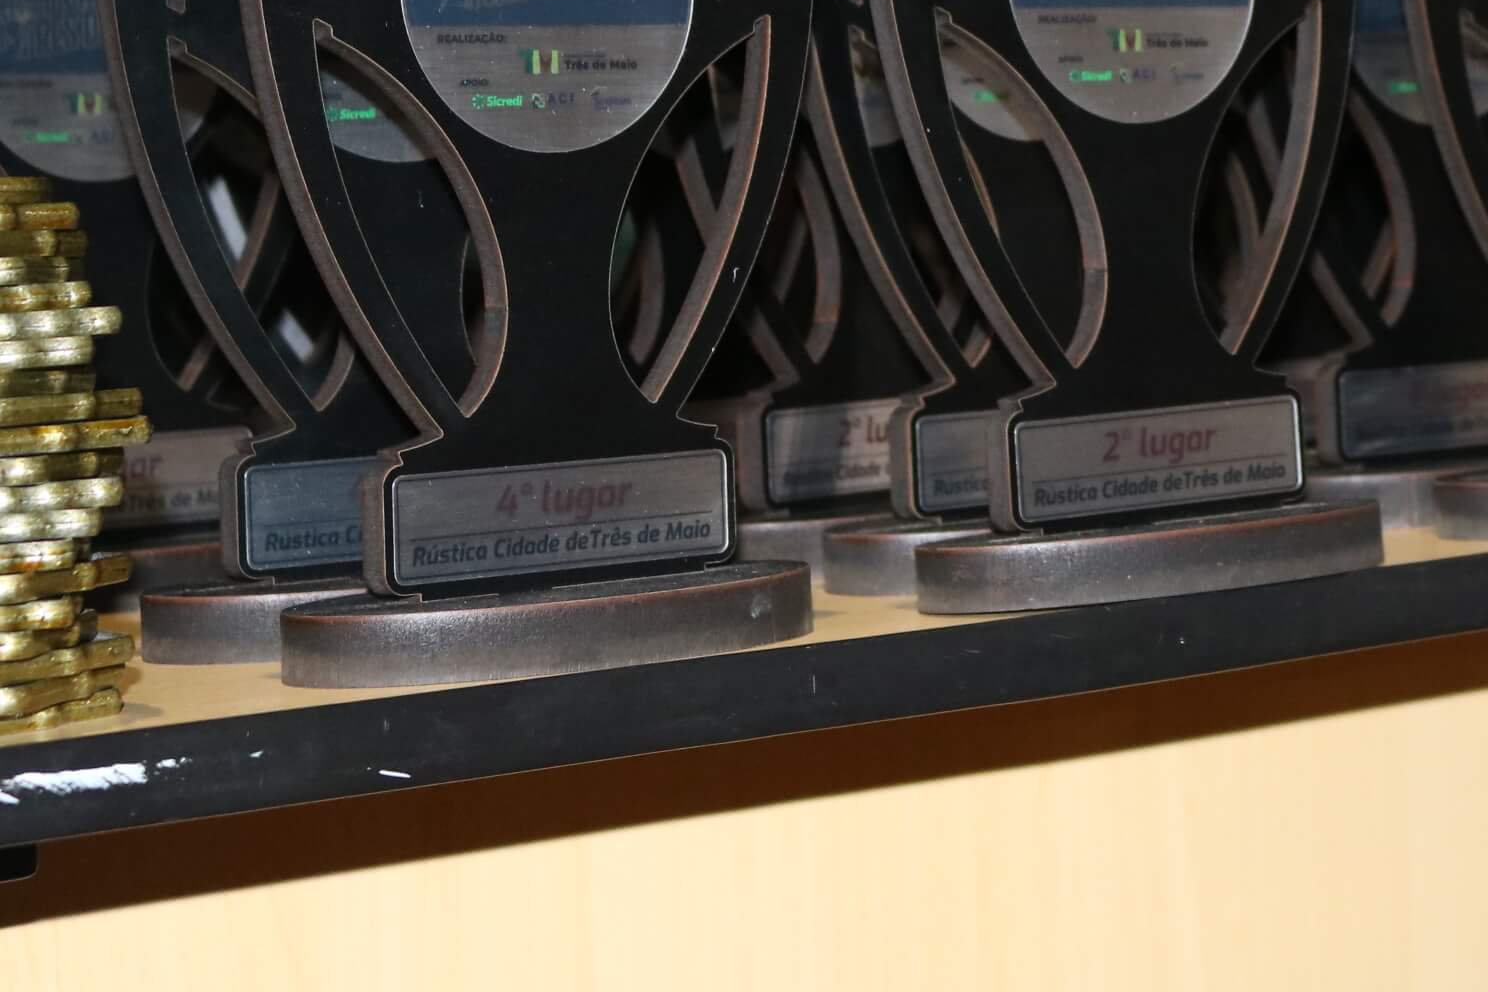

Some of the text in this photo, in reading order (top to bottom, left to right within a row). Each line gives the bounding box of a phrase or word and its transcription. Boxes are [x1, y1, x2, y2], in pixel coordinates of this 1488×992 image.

[486, 93, 524, 108] Sicredi
[1139, 426, 1217, 465] lugar
[1102, 476, 1158, 500] Cidade
[1223, 467, 1243, 485] de
[1247, 462, 1287, 481] Maio
[541, 479, 632, 526] lugar
[411, 540, 488, 568] Rústica
[493, 533, 560, 559] Cidade
[637, 524, 660, 546] de
[665, 518, 711, 541] Maio
